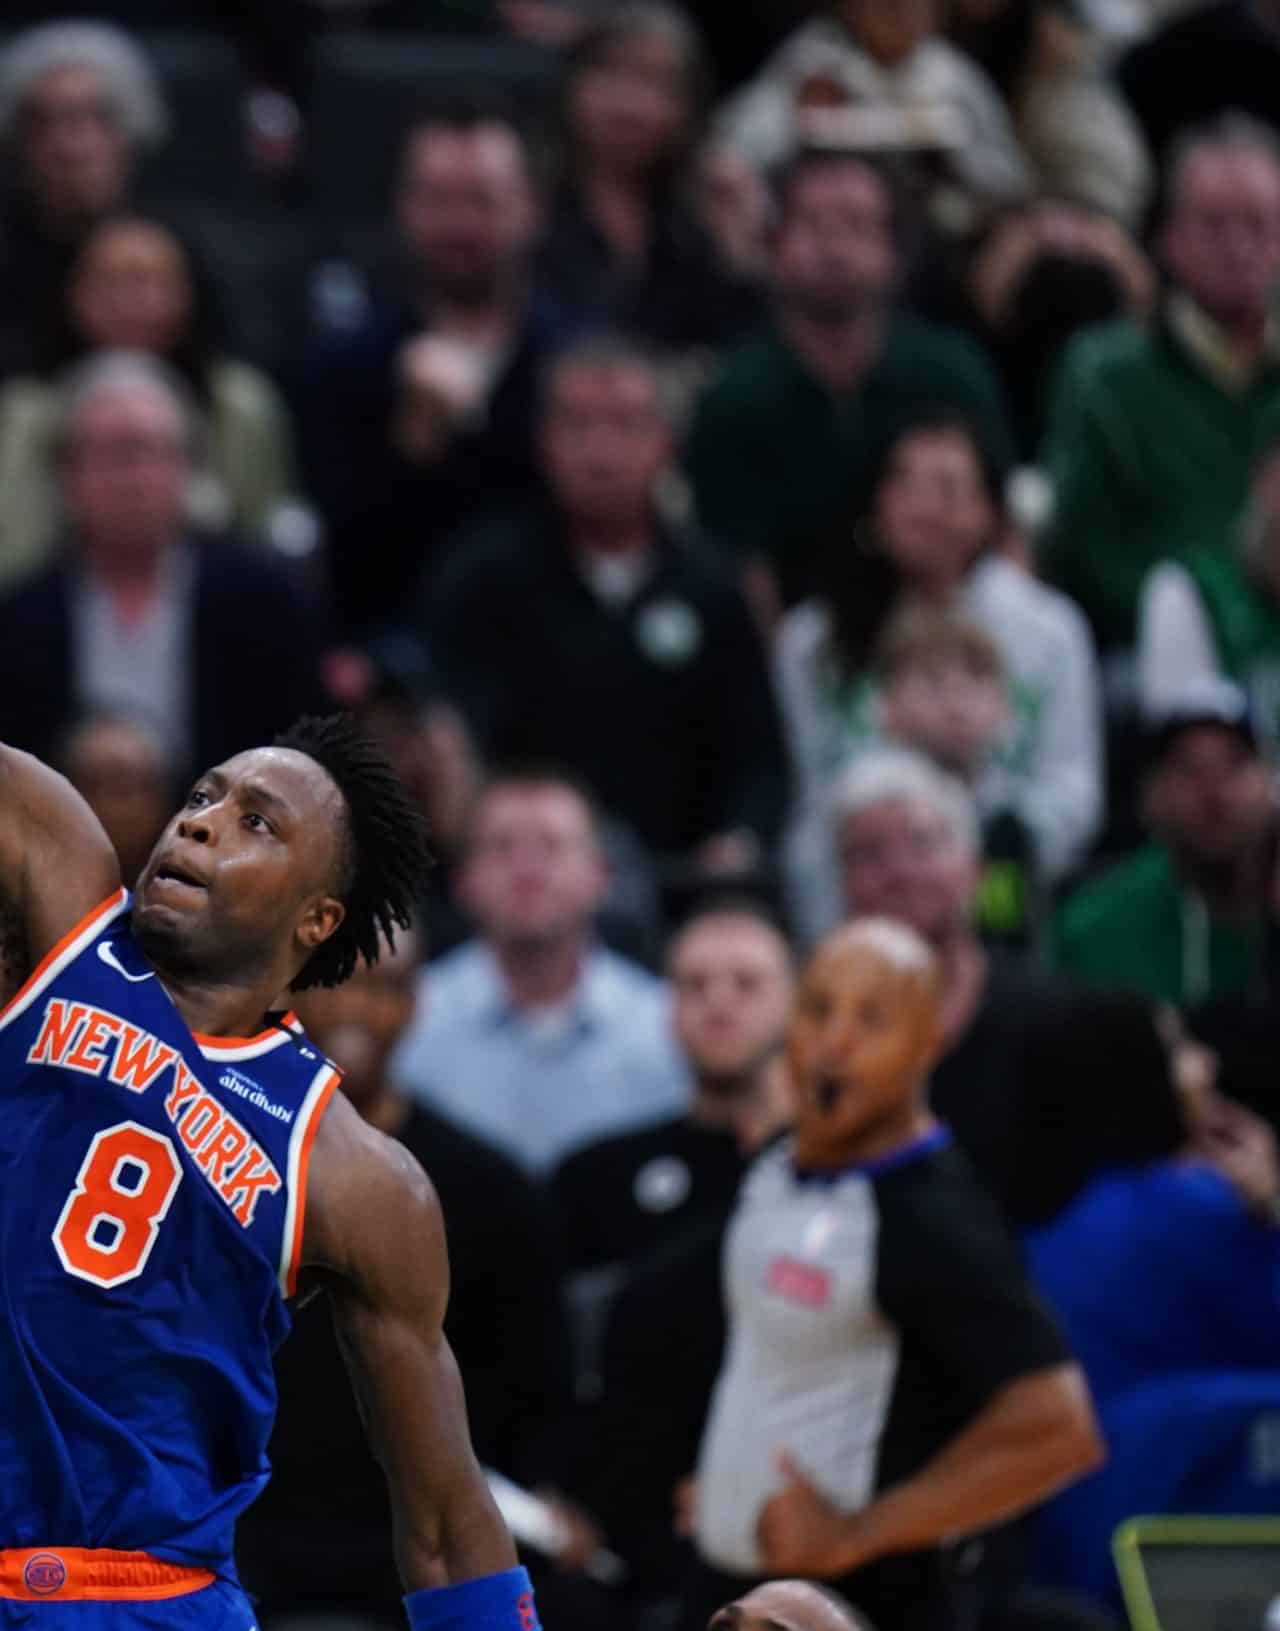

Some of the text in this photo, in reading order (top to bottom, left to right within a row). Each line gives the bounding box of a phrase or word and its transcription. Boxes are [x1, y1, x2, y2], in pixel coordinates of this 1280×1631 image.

[26, 998, 282, 1228] NEW YORK
[219, 1075, 251, 1099] abu
[249, 1091, 294, 1123] dhabi
[51, 1120, 184, 1289] 8
